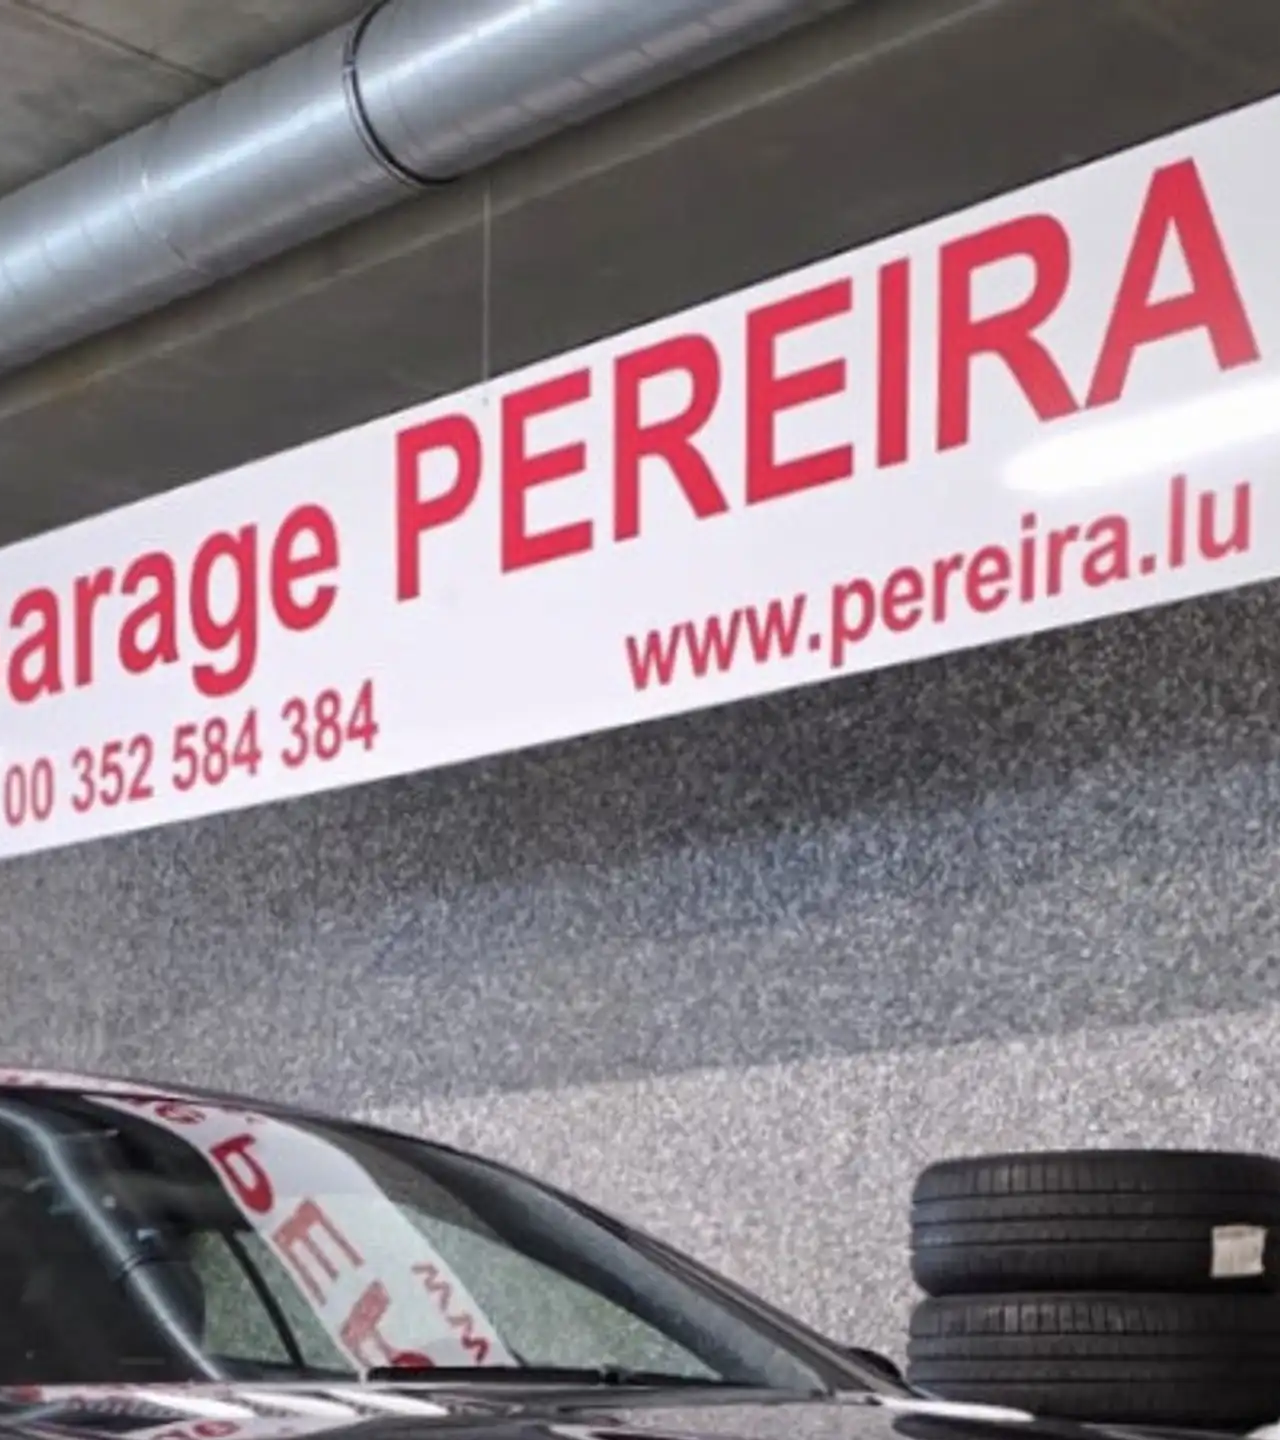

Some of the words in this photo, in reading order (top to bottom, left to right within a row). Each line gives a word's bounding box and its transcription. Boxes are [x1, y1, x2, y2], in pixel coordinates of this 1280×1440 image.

[393, 158, 1260, 604] PEREIRA
[624, 474, 1253, 694] www.pereira.lu
[3, 757, 56, 827] 00
[69, 733, 155, 815] 352
[171, 710, 264, 793] 584
[280, 680, 380, 770] 384
